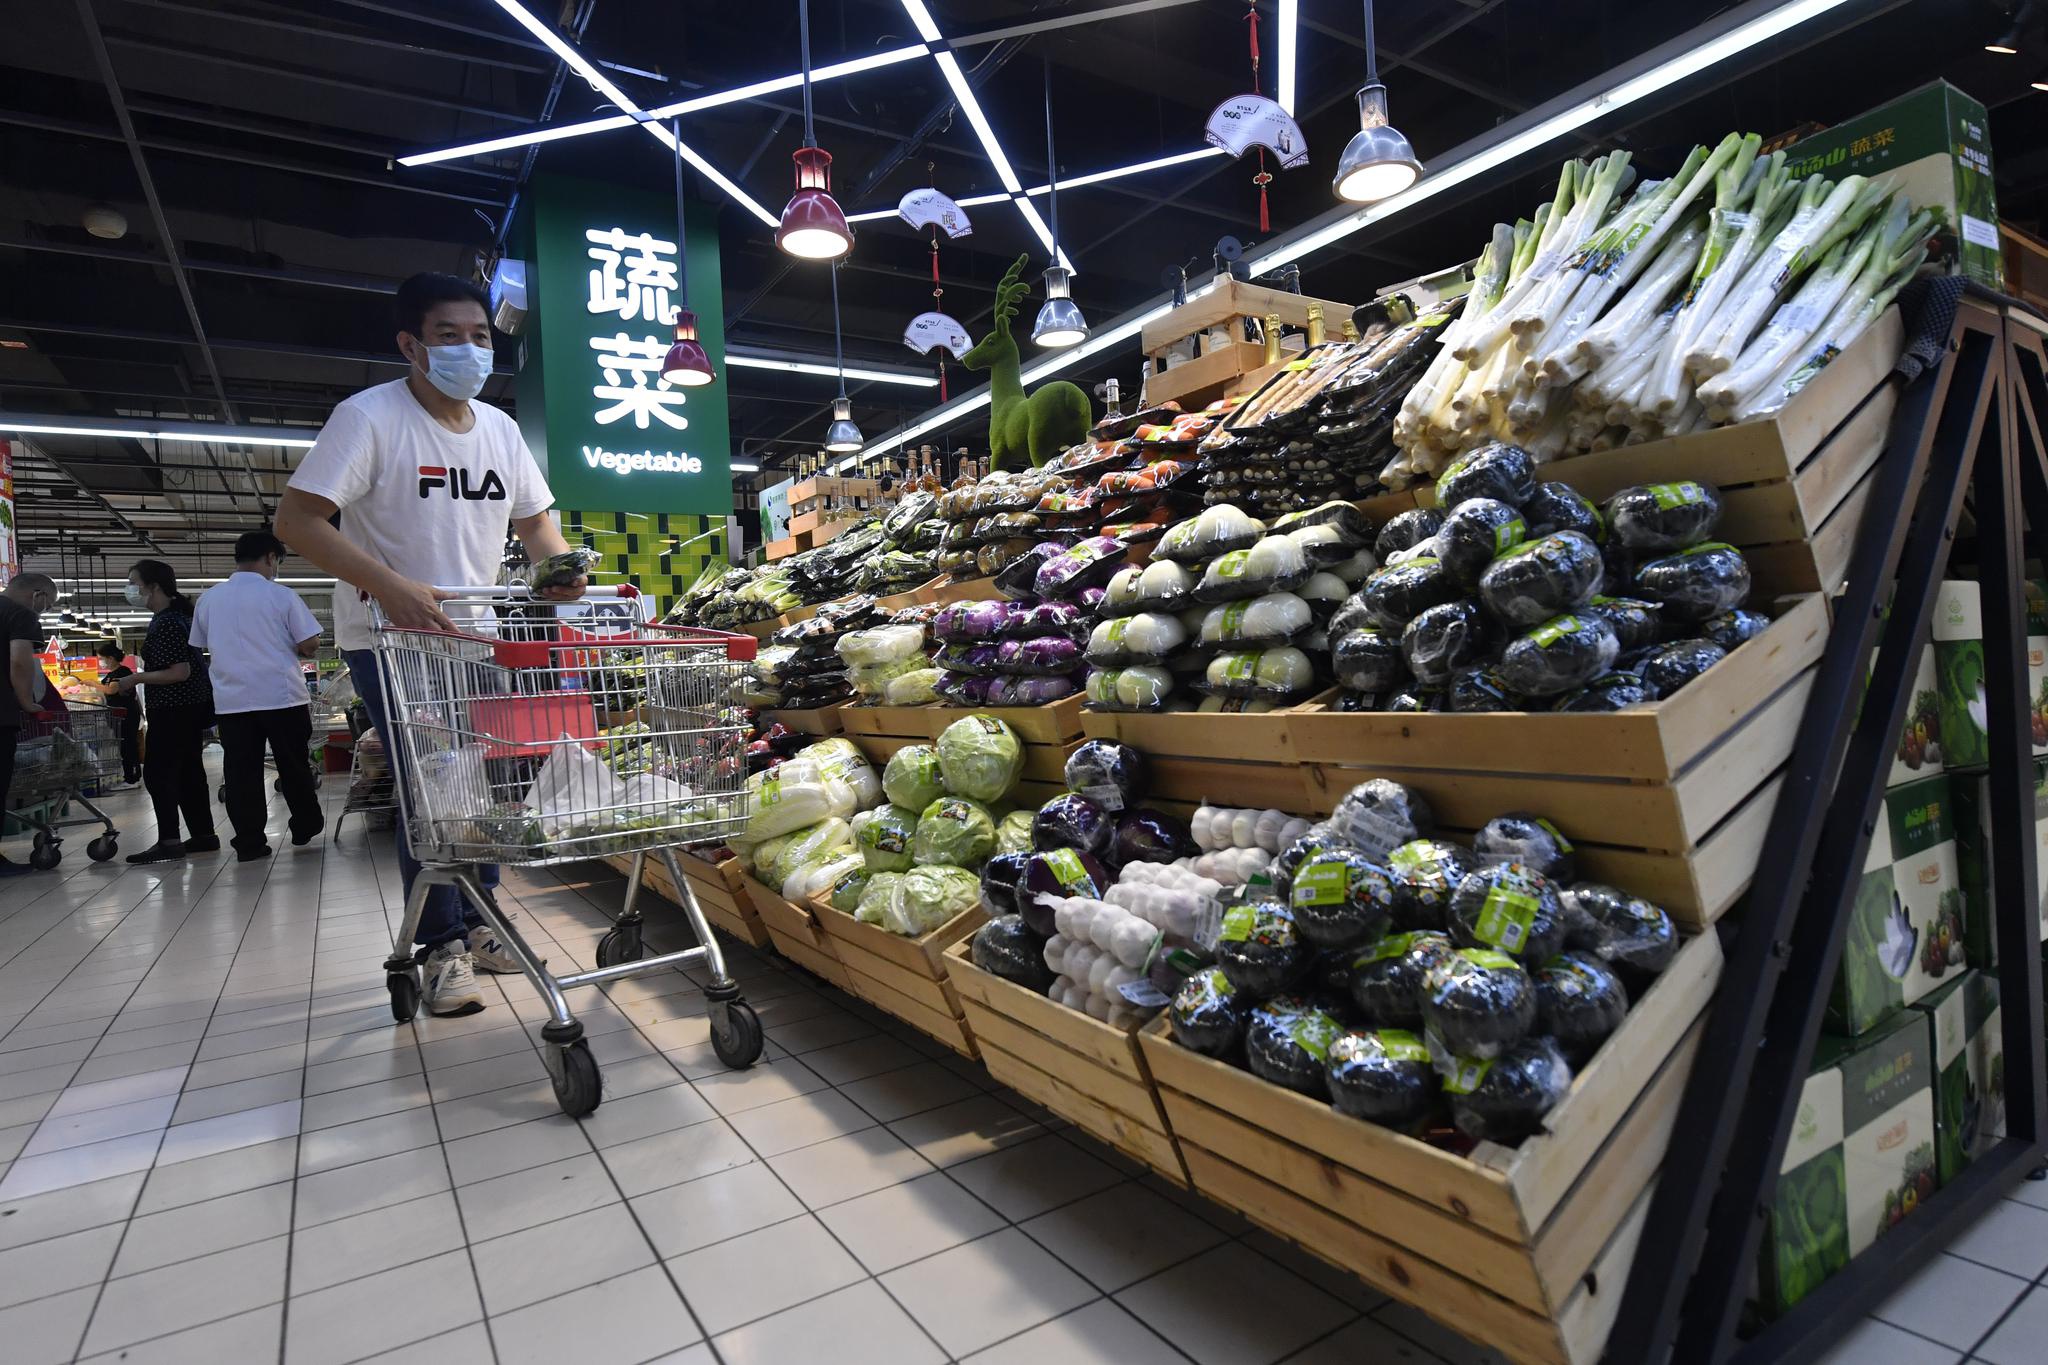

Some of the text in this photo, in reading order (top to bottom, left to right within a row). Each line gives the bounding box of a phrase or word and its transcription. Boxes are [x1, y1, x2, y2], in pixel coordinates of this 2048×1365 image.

[1850, 127, 1896, 157] 蔬菜
[585, 227, 689, 431] 蔬菜
[582, 445, 702, 475] Vegetable
[419, 466, 506, 500] FILA
